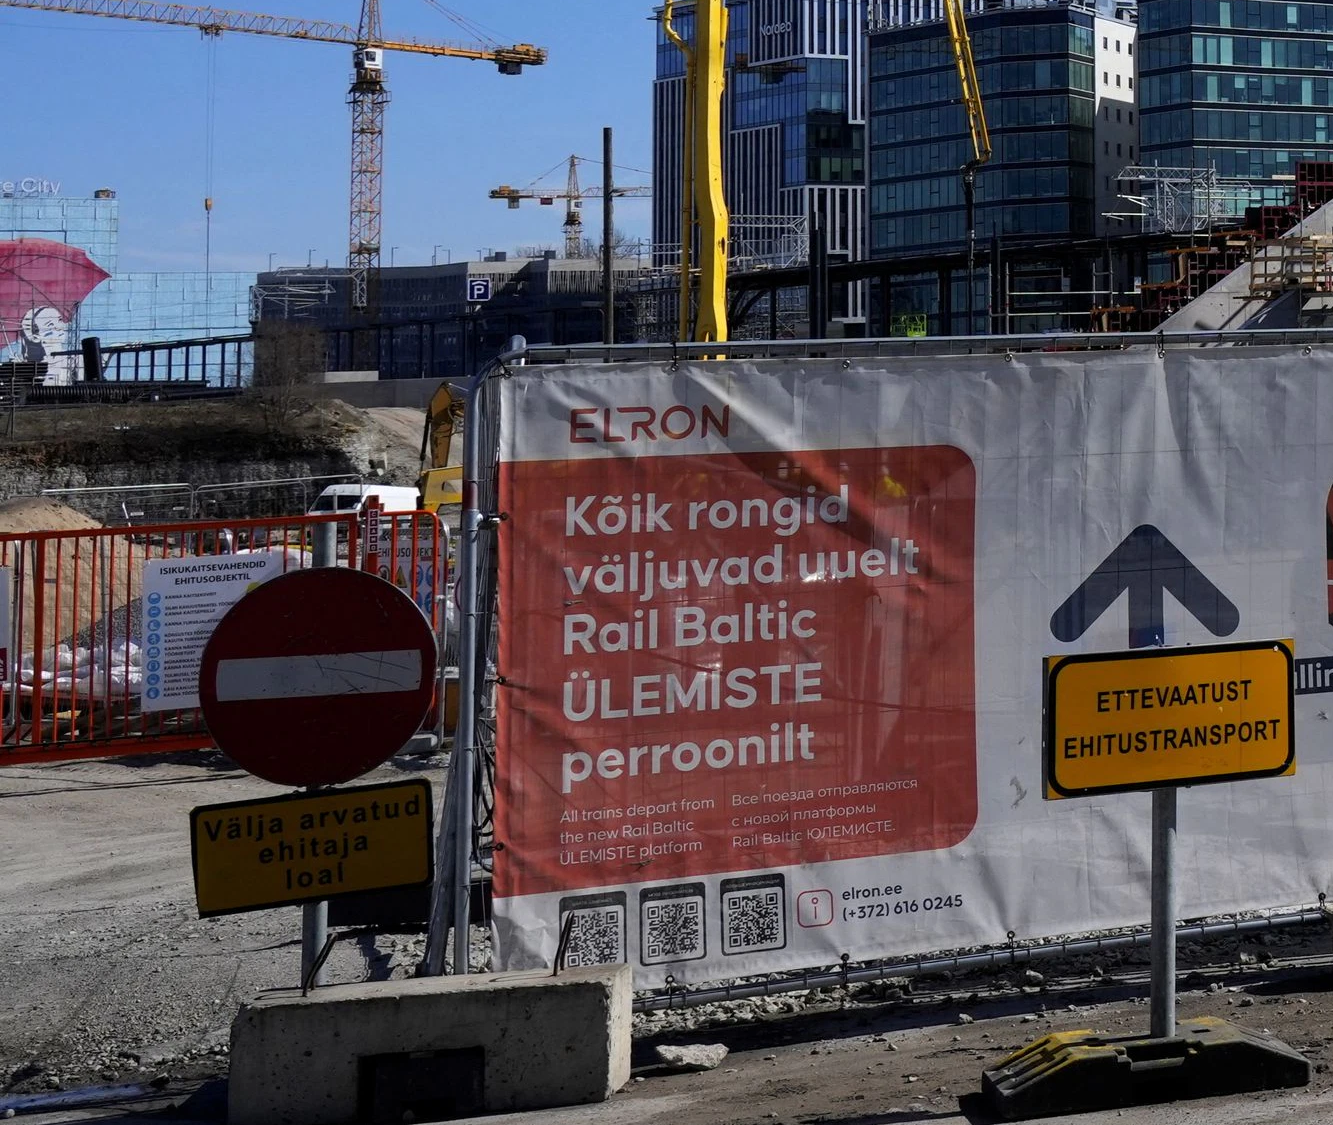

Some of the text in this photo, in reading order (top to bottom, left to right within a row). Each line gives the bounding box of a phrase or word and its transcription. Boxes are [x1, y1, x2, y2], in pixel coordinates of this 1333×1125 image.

[760, 21, 793, 37] Nordea
[21, 177, 62, 196] City
[569, 405, 730, 443] ELRON
[565, 484, 849, 539] Kõik rongid
[160, 560, 266, 575] ISIKUKAITSEVAHENDID
[175, 573, 251, 586] EHITUSOBJEKTIL
[563, 538, 920, 602] väljuvad uuelt
[563, 600, 818, 656] Rail Baltic
[562, 662, 823, 723] ÜLEMISTE
[1096, 678, 1254, 713] ETTEVAATUST
[1063, 718, 1282, 760] EHITUSTRANSPORT
[560, 722, 816, 795] perroonilt
[732, 778, 918, 808] Все поезда отправляются
[203, 793, 421, 844] Välja arvatud
[560, 796, 716, 824] All trains depart from
[743, 808, 790, 827] новой
[792, 802, 877, 825] платформы
[560, 818, 695, 845] the new Rail Baltic
[732, 819, 897, 849] Rail Baltic ЮЛЕМИСТЕ.
[258, 832, 369, 867] ehitaja
[559, 839, 703, 867] ÜLEMISTE platform
[286, 861, 345, 890] loal
[841, 881, 904, 902] elron.ee
[841, 893, 964, 924] (+372) 616 0245
